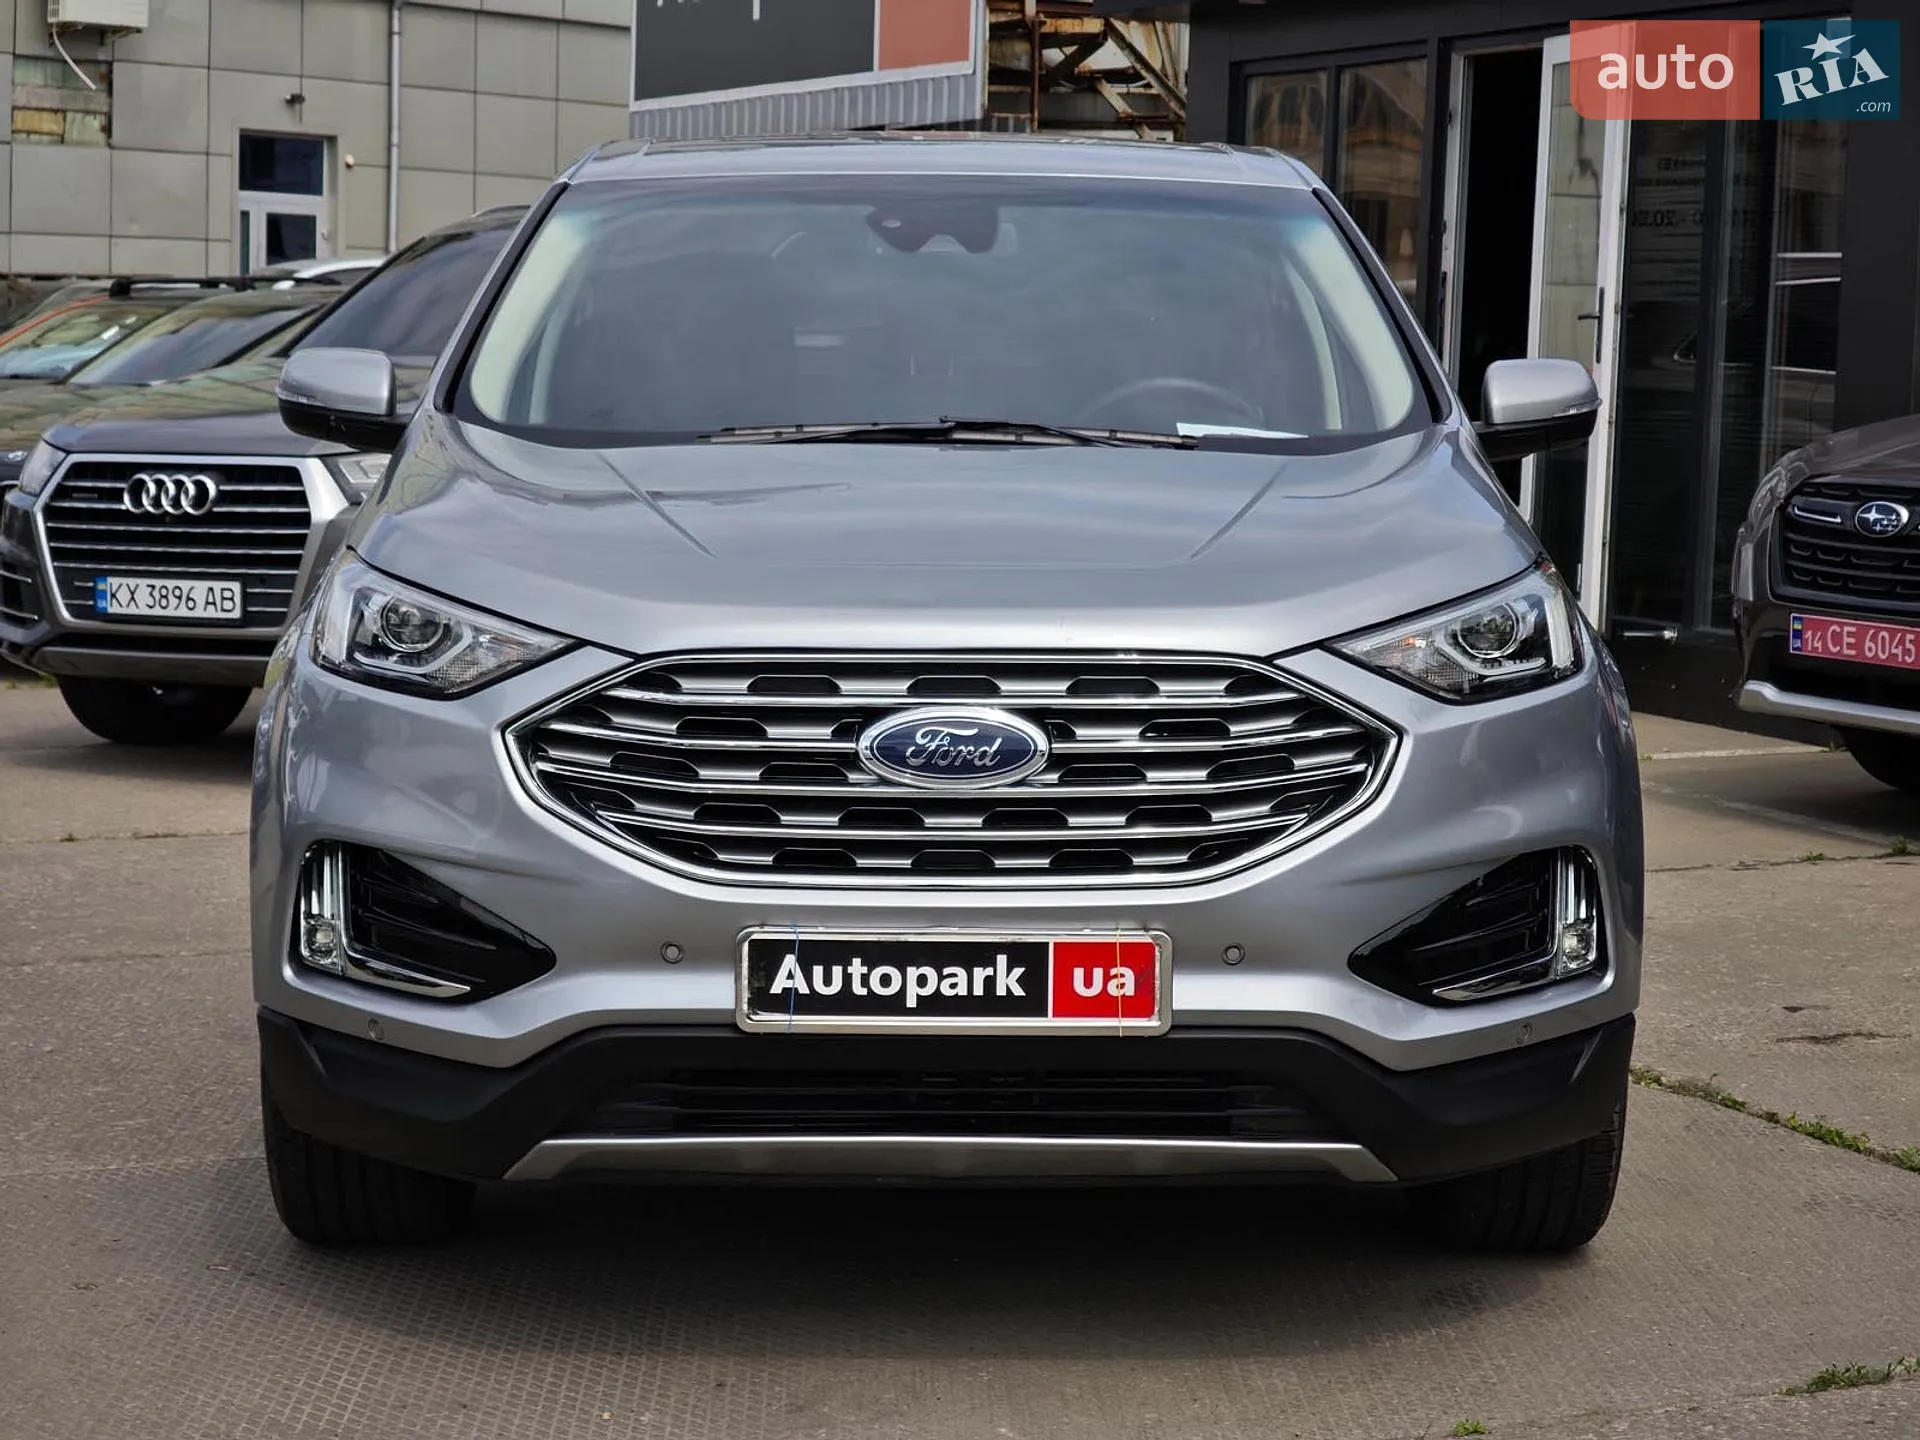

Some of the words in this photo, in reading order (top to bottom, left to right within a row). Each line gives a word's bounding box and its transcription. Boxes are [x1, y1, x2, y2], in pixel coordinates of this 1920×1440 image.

[109, 582, 139, 609] KX
[145, 584, 197, 611] 3896
[203, 586, 237, 613] AB
[1864, 629, 1916, 664] 6045
[905, 726, 1002, 767] Ford
[768, 953, 1027, 1009] Autopark
[1072, 965, 1136, 998] ua
